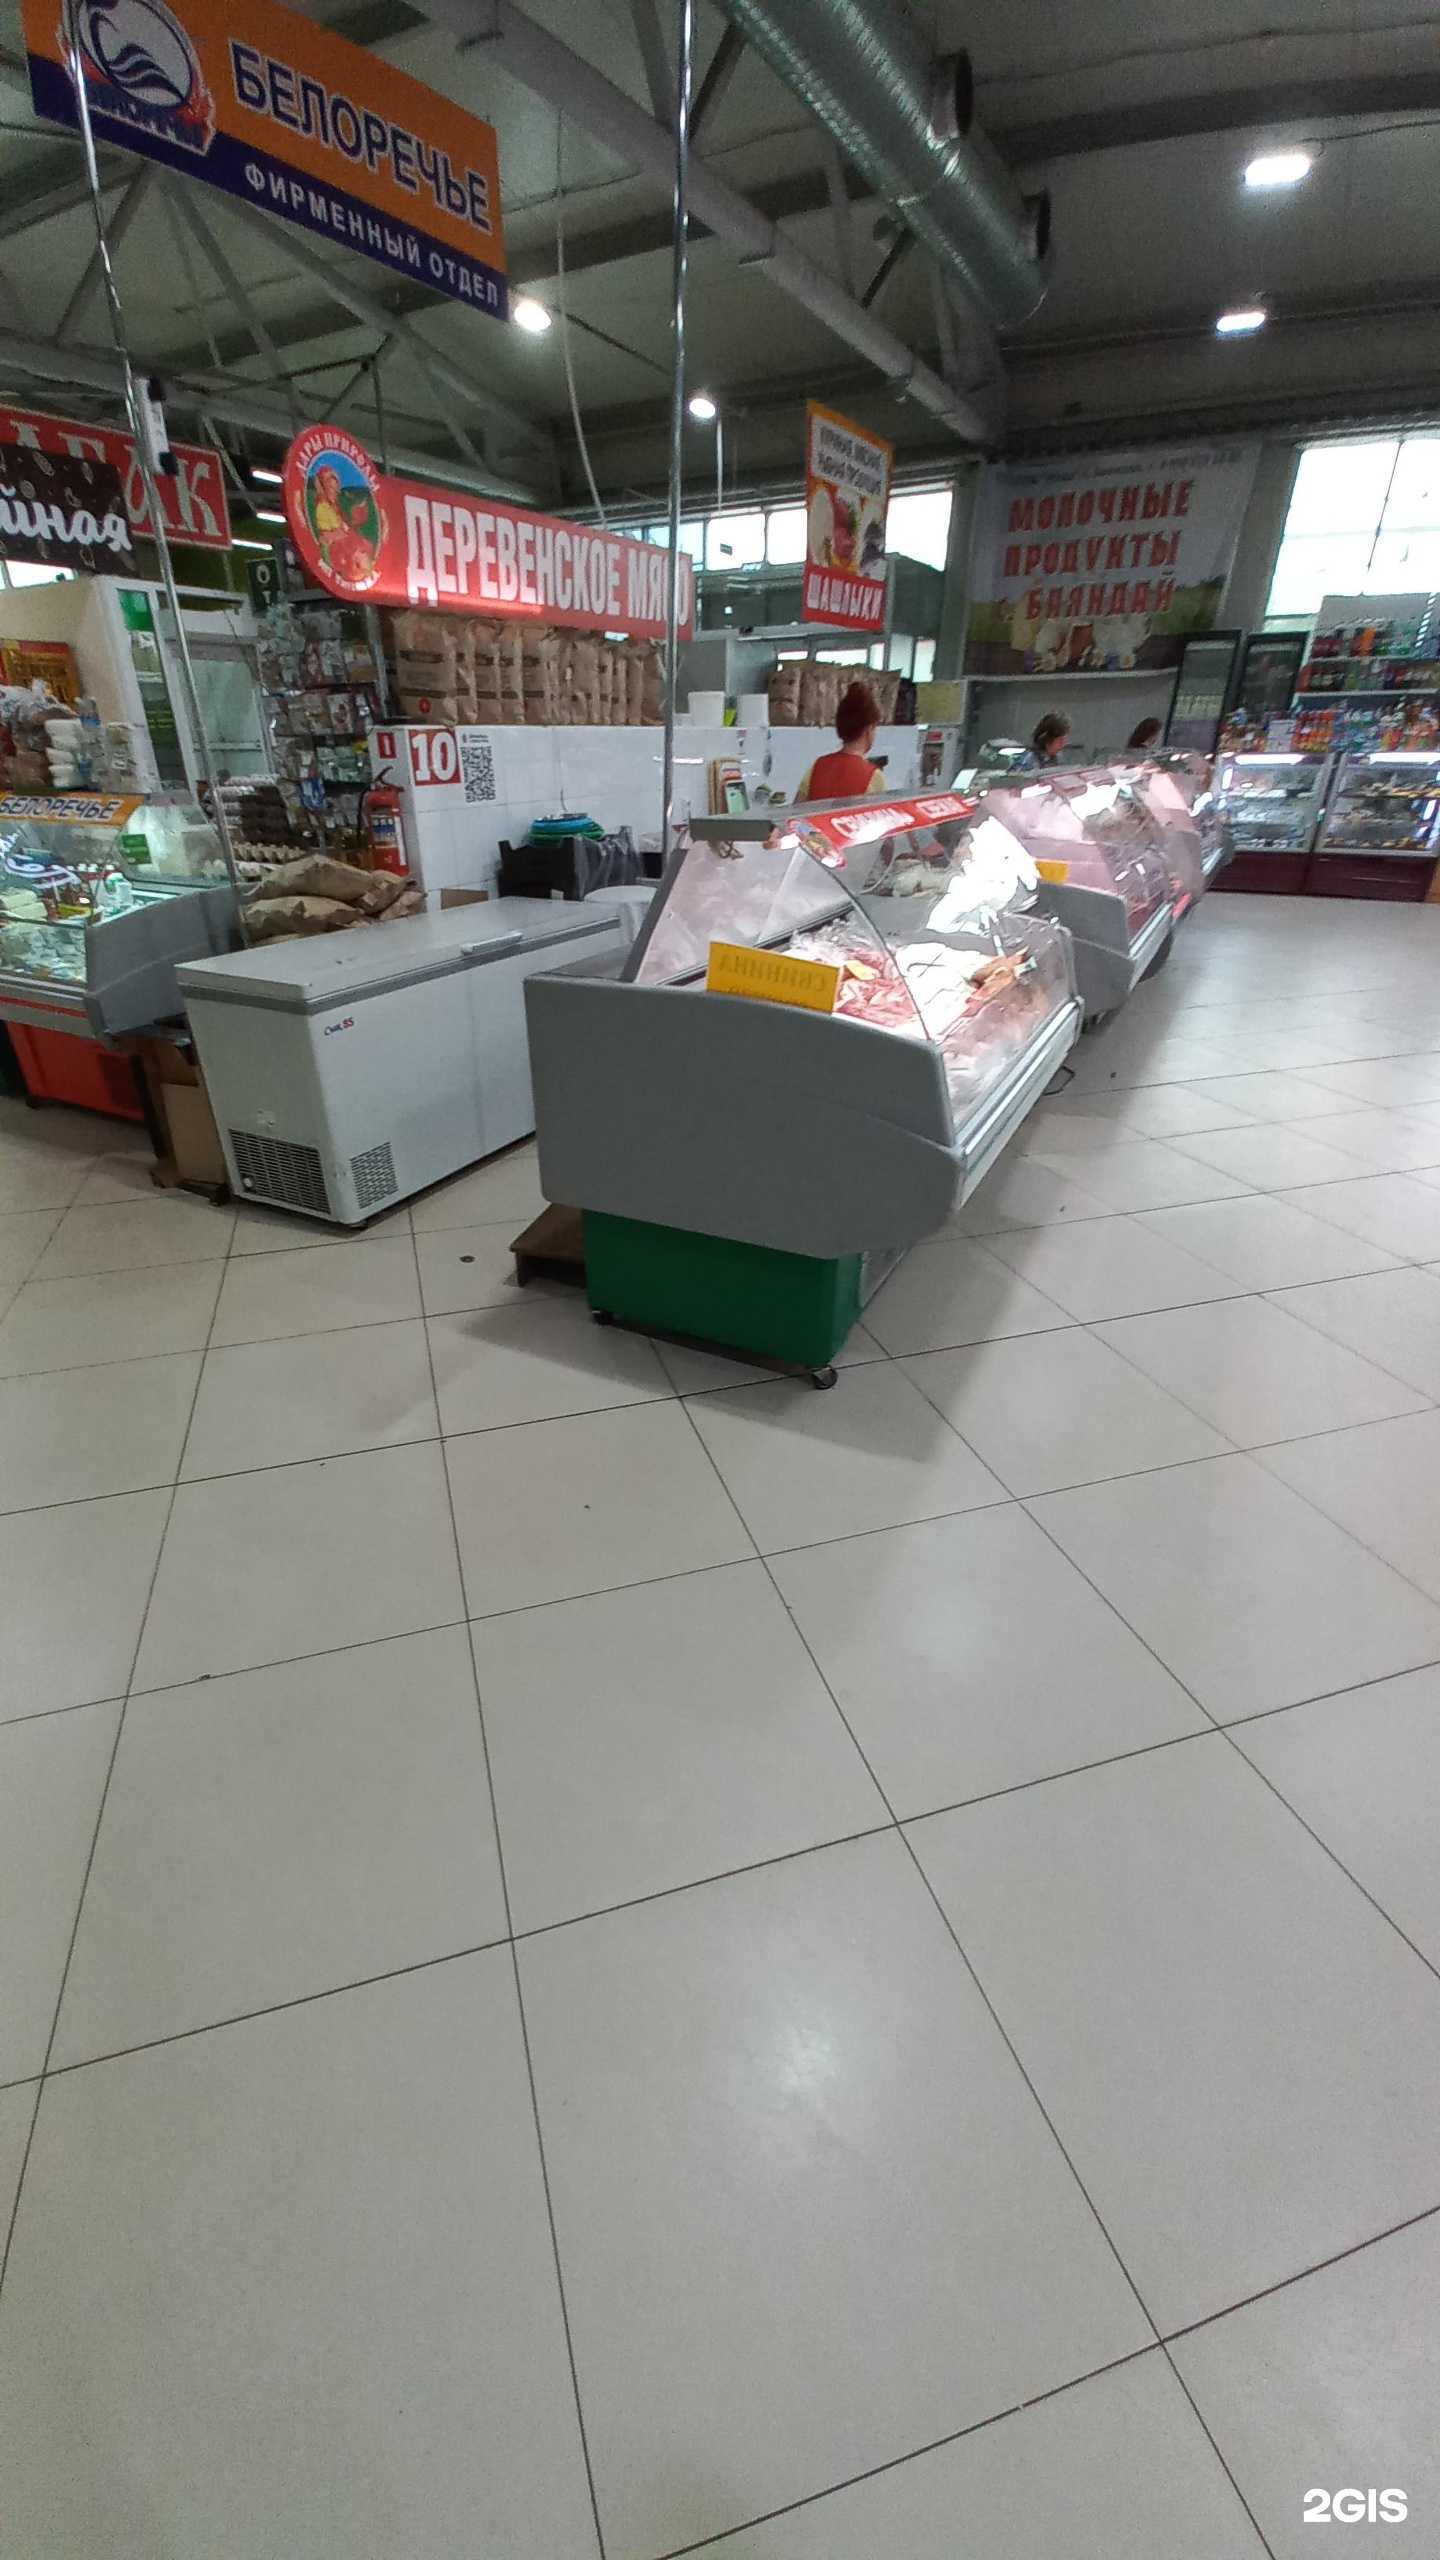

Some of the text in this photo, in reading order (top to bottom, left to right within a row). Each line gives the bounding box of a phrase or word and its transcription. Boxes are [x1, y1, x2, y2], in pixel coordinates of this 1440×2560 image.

[229, 38, 493, 236] БЕЛОРЕЧЬЕ
[244, 161, 499, 307] ФИРМЕННЫЙ ОТДЕЛ
[1008, 479, 1194, 533] МОЛОЧНЫЕ
[404, 495, 621, 608] ДЕРЕВЕНСКОЕ
[1003, 530, 1182, 577] ПРОДУКТЫ
[807, 573, 883, 621] ШАШЛЫКИ
[411, 731, 457, 781] 10
